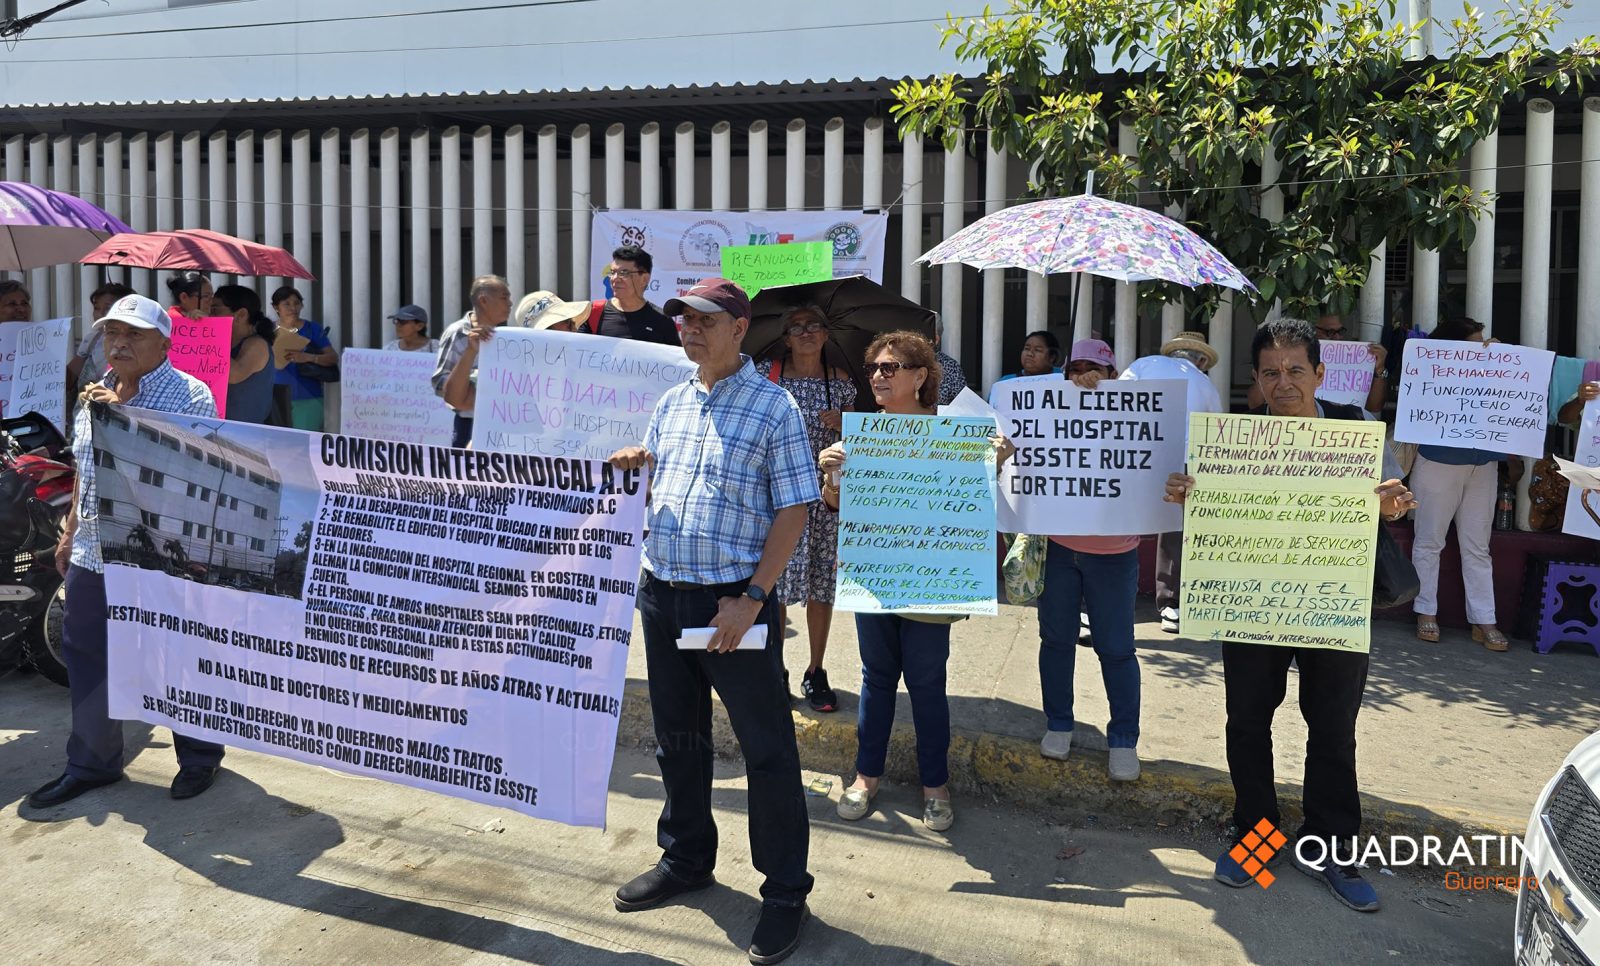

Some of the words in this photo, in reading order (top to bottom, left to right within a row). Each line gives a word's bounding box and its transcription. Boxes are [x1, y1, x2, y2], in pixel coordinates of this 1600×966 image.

[731, 272, 746, 282] DE
[755, 272, 786, 280] TODOS
[21, 326, 46, 356] NO
[202, 326, 216, 338] EL
[170, 343, 224, 358] GENERAL
[496, 337, 534, 367] POR
[544, 346, 566, 367] LA
[576, 350, 694, 382] TERMINACIO
[1416, 346, 1522, 366] DEFENDEMOS
[20, 360, 60, 381] CIERRE
[1432, 364, 1530, 382] PERMANENCIA
[1012, 390, 1034, 410] NO
[1042, 390, 1070, 410] AL
[1079, 391, 1162, 412] CIERRE
[1422, 382, 1544, 402] FUNCIONAMIENTO
[1456, 398, 1510, 412] PLENO
[1524, 401, 1542, 416] del
[574, 411, 644, 442] HOSPITAL
[862, 418, 932, 436] EXIGIMOS
[952, 424, 996, 438] ISSSTE
[1410, 409, 1477, 424] HOSPITAL
[1488, 415, 1545, 430] GENERAL
[1054, 420, 1164, 441] HOSPITAL
[1440, 426, 1508, 442] ISSSTE
[486, 430, 516, 448] NAL
[523, 436, 542, 453] DE
[321, 434, 424, 476] COMISION
[429, 446, 596, 494] INTERSINDICAL
[850, 448, 906, 458] INMEDIATO
[928, 451, 956, 461] NUEVO
[1011, 447, 1090, 468] ISSSTE
[1100, 450, 1152, 470] RUIZ
[1197, 463, 1262, 475] INMEDIATO
[1263, 464, 1283, 476] DEL
[1284, 466, 1322, 477] NUEVO
[846, 484, 876, 492] SIGA
[881, 484, 968, 498] FUNCIONANDO
[960, 476, 985, 486] QUE
[1011, 476, 1121, 498] CORTINES
[475, 499, 508, 516] ISSSTE
[526, 490, 594, 514] PENSIONADOS
[850, 495, 918, 510] HOSPITAL
[1298, 494, 1323, 508] QUE
[1328, 496, 1366, 508] SIGA
[1190, 508, 1272, 520] FUNCIONANDO
[344, 512, 394, 530] REHABILITE
[408, 520, 446, 540] EDIFICIO
[496, 534, 576, 556] MEJORAMIENTO
[450, 510, 493, 530] HOSPITAL
[496, 518, 538, 538] UBICADO
[554, 527, 580, 541] RUIZ
[843, 522, 922, 536] MEJORAMIENTO
[939, 526, 989, 539] SERVICIOS
[857, 538, 870, 546] LA
[1192, 534, 1284, 550] MEJORAMIENTO
[1289, 537, 1302, 548] DE
[1304, 536, 1369, 552] SERVICIOS
[844, 562, 913, 574] ENTREVISTA
[917, 566, 942, 576] CON
[949, 567, 974, 576] EL
[1190, 552, 1204, 560] DE
[1208, 552, 1224, 561] LA
[1282, 554, 1300, 564] DE
[1302, 554, 1368, 566] ACAPULCO
[312, 552, 348, 570] ALEMAN
[412, 567, 480, 594] INTERSINDICAL
[484, 582, 528, 598] SEAMOS
[531, 585, 583, 604] TOMADOS
[350, 542, 414, 566] INAGURACION
[432, 555, 474, 576] HOSPITAL
[477, 564, 526, 582] REGIONAL
[548, 572, 595, 590] COSTERA
[599, 576, 636, 597] MIGUEL
[842, 576, 898, 588] DIRECTOR
[924, 578, 982, 590] ISSSTE
[1190, 580, 1262, 592] ENTREVISTA
[1271, 584, 1308, 594] CON
[1316, 582, 1354, 594] EL
[330, 585, 374, 605] PERSONAL
[389, 595, 422, 614] AMBOS
[424, 602, 484, 622] HOSPITALES
[486, 610, 512, 626] SEAN
[516, 614, 594, 639] PROFECIONALES
[1187, 593, 1253, 607] DIRECTOR
[1261, 596, 1289, 608] DEL
[1298, 598, 1368, 612] ISSSTE
[1226, 608, 1269, 624] BATRES
[305, 626, 345, 646] PREMIOS
[328, 615, 378, 636] QUEREMOS
[380, 626, 427, 646] PERSONAL
[428, 634, 459, 650] AJENO
[471, 639, 504, 654] ESTAS
[398, 612, 440, 632] BRINDAR
[442, 620, 492, 638] ATENCION
[496, 626, 528, 642] DIGNA
[538, 630, 576, 651] CALIDEZ
[1276, 634, 1352, 648] INTERSINDICAL
[160, 613, 180, 632] POR
[231, 630, 294, 658] CENTRALES
[296, 643, 346, 668] DESVIOS
[368, 660, 436, 684] RECURSOS
[441, 670, 458, 686] DE
[462, 670, 500, 692] AÑOS
[502, 676, 542, 700] ATRAS
[556, 688, 619, 718] ACTUALES
[239, 668, 268, 690] FALTA
[288, 678, 350, 706] DOCTORES
[363, 694, 468, 726] MEDICAMENTOS
[178, 689, 212, 710] SALUD
[246, 706, 298, 732] DERECHO
[336, 726, 404, 754] QUEREMOS
[407, 740, 450, 764] MALOS
[157, 700, 201, 726] RESPETEN
[204, 714, 261, 741] NUESTROS
[264, 729, 324, 755] DERECHOS
[326, 742, 360, 765] COMO
[364, 752, 492, 793] DERECHOHABIENTES
[494, 777, 538, 806] ISSSTE
